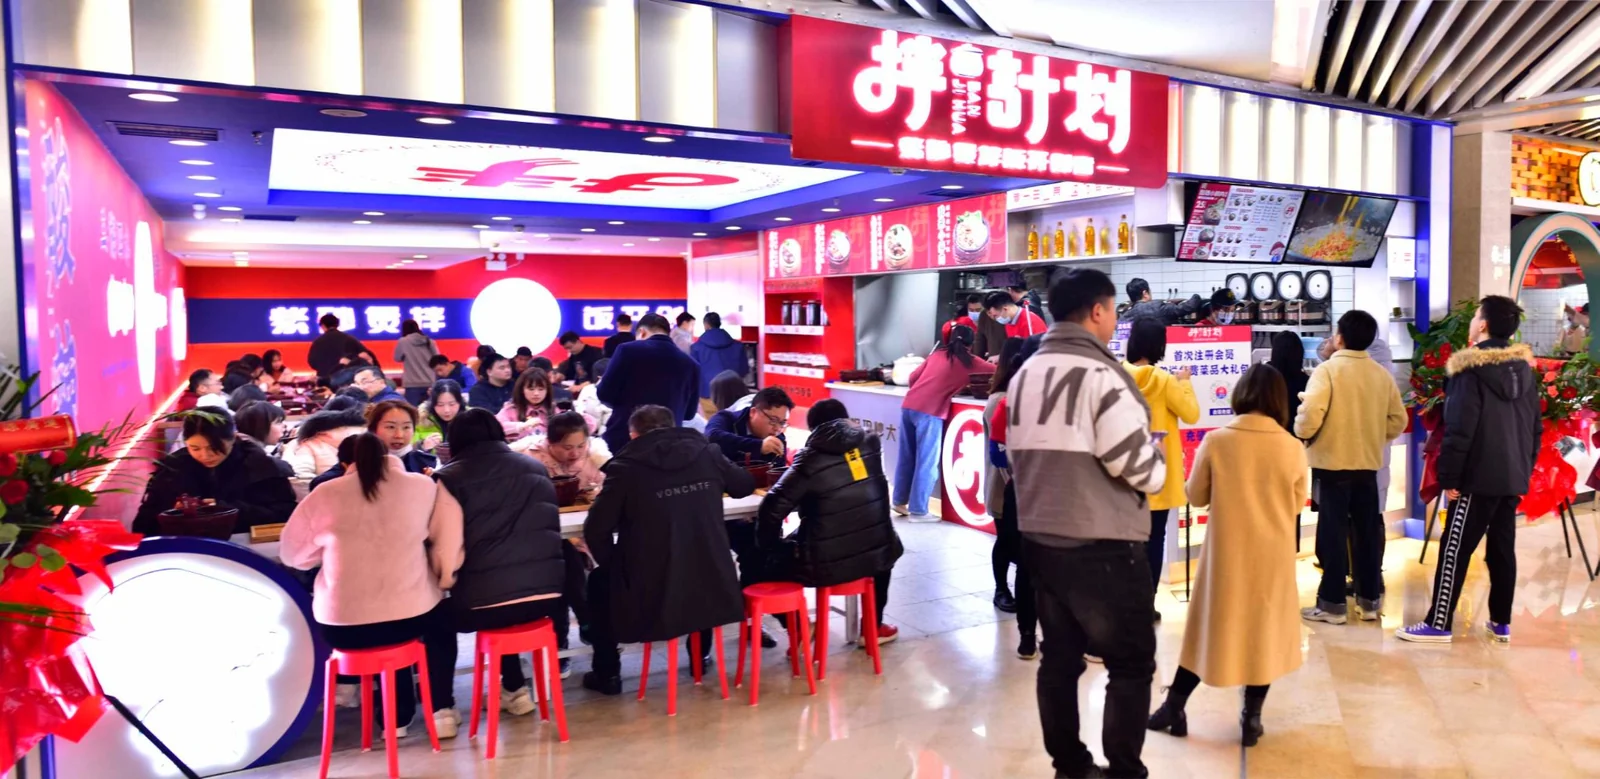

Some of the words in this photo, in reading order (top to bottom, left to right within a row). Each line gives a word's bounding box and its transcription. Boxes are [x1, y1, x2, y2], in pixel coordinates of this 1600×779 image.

[1174, 349, 1234, 361] 首次注册会员
